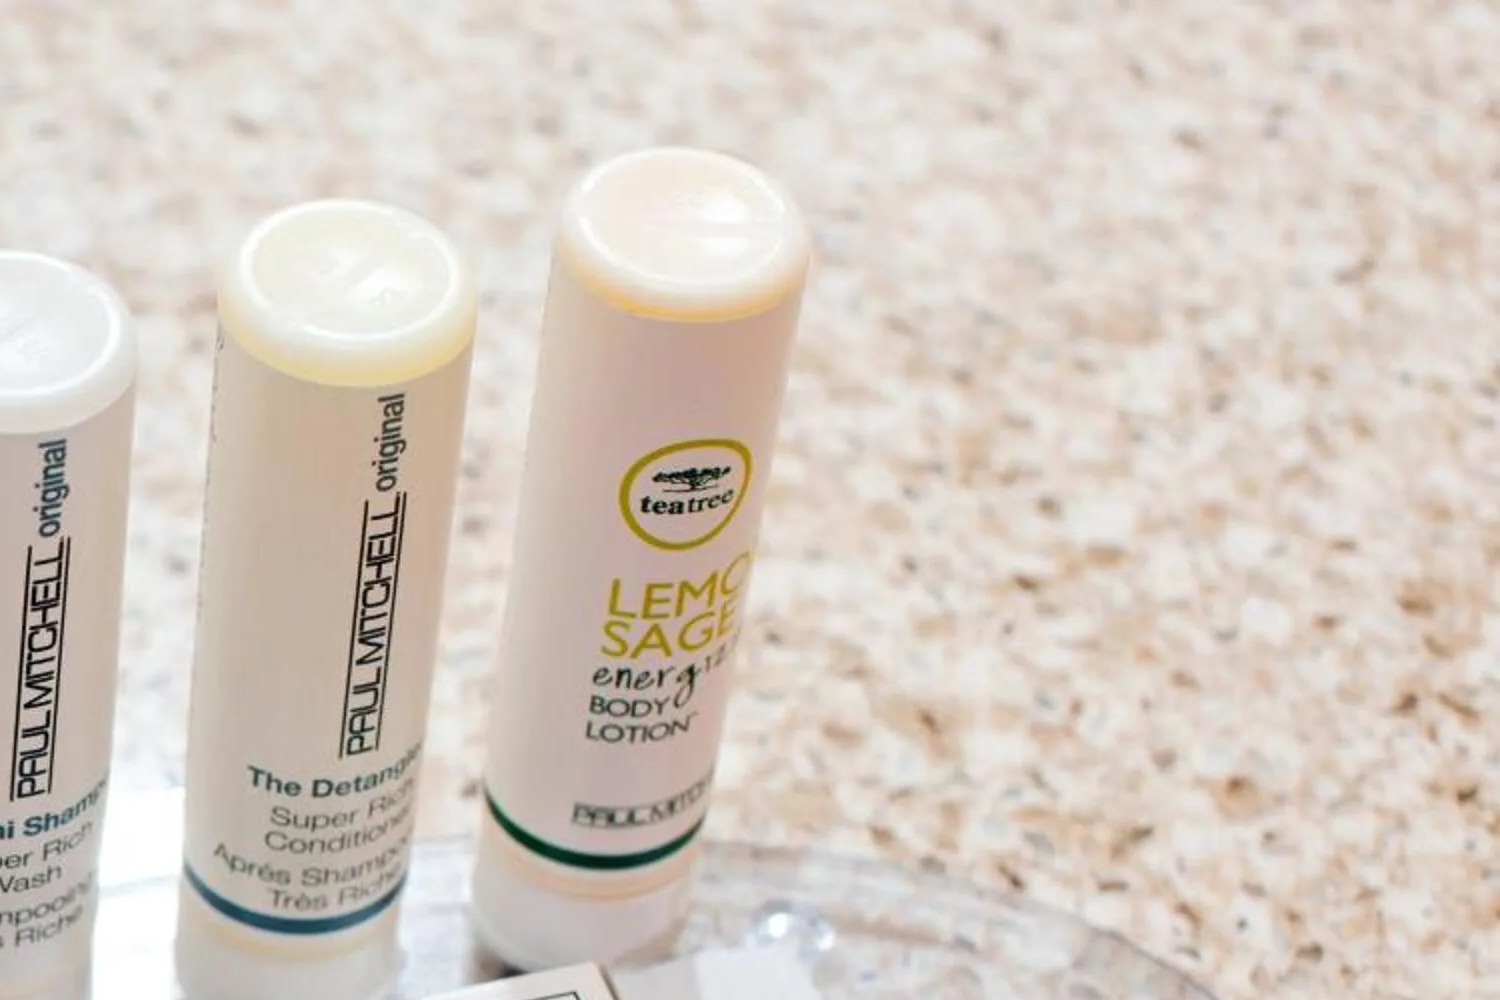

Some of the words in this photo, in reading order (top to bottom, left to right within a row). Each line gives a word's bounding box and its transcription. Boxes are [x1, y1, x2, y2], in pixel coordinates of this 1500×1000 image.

[369, 392, 407, 493] original
[32, 438, 70, 537] original
[356, 492, 400, 667] MITCHELL
[23, 537, 64, 709] MITCHELL
[601, 599, 738, 659] SAGE
[347, 667, 383, 756] PAUL
[585, 714, 692, 744] LOTION
[589, 695, 670, 718] BODY
[16, 709, 52, 799] PAUL
[248, 765, 302, 798] The
[42, 820, 93, 861] Rich
[270, 805, 360, 833] Super
